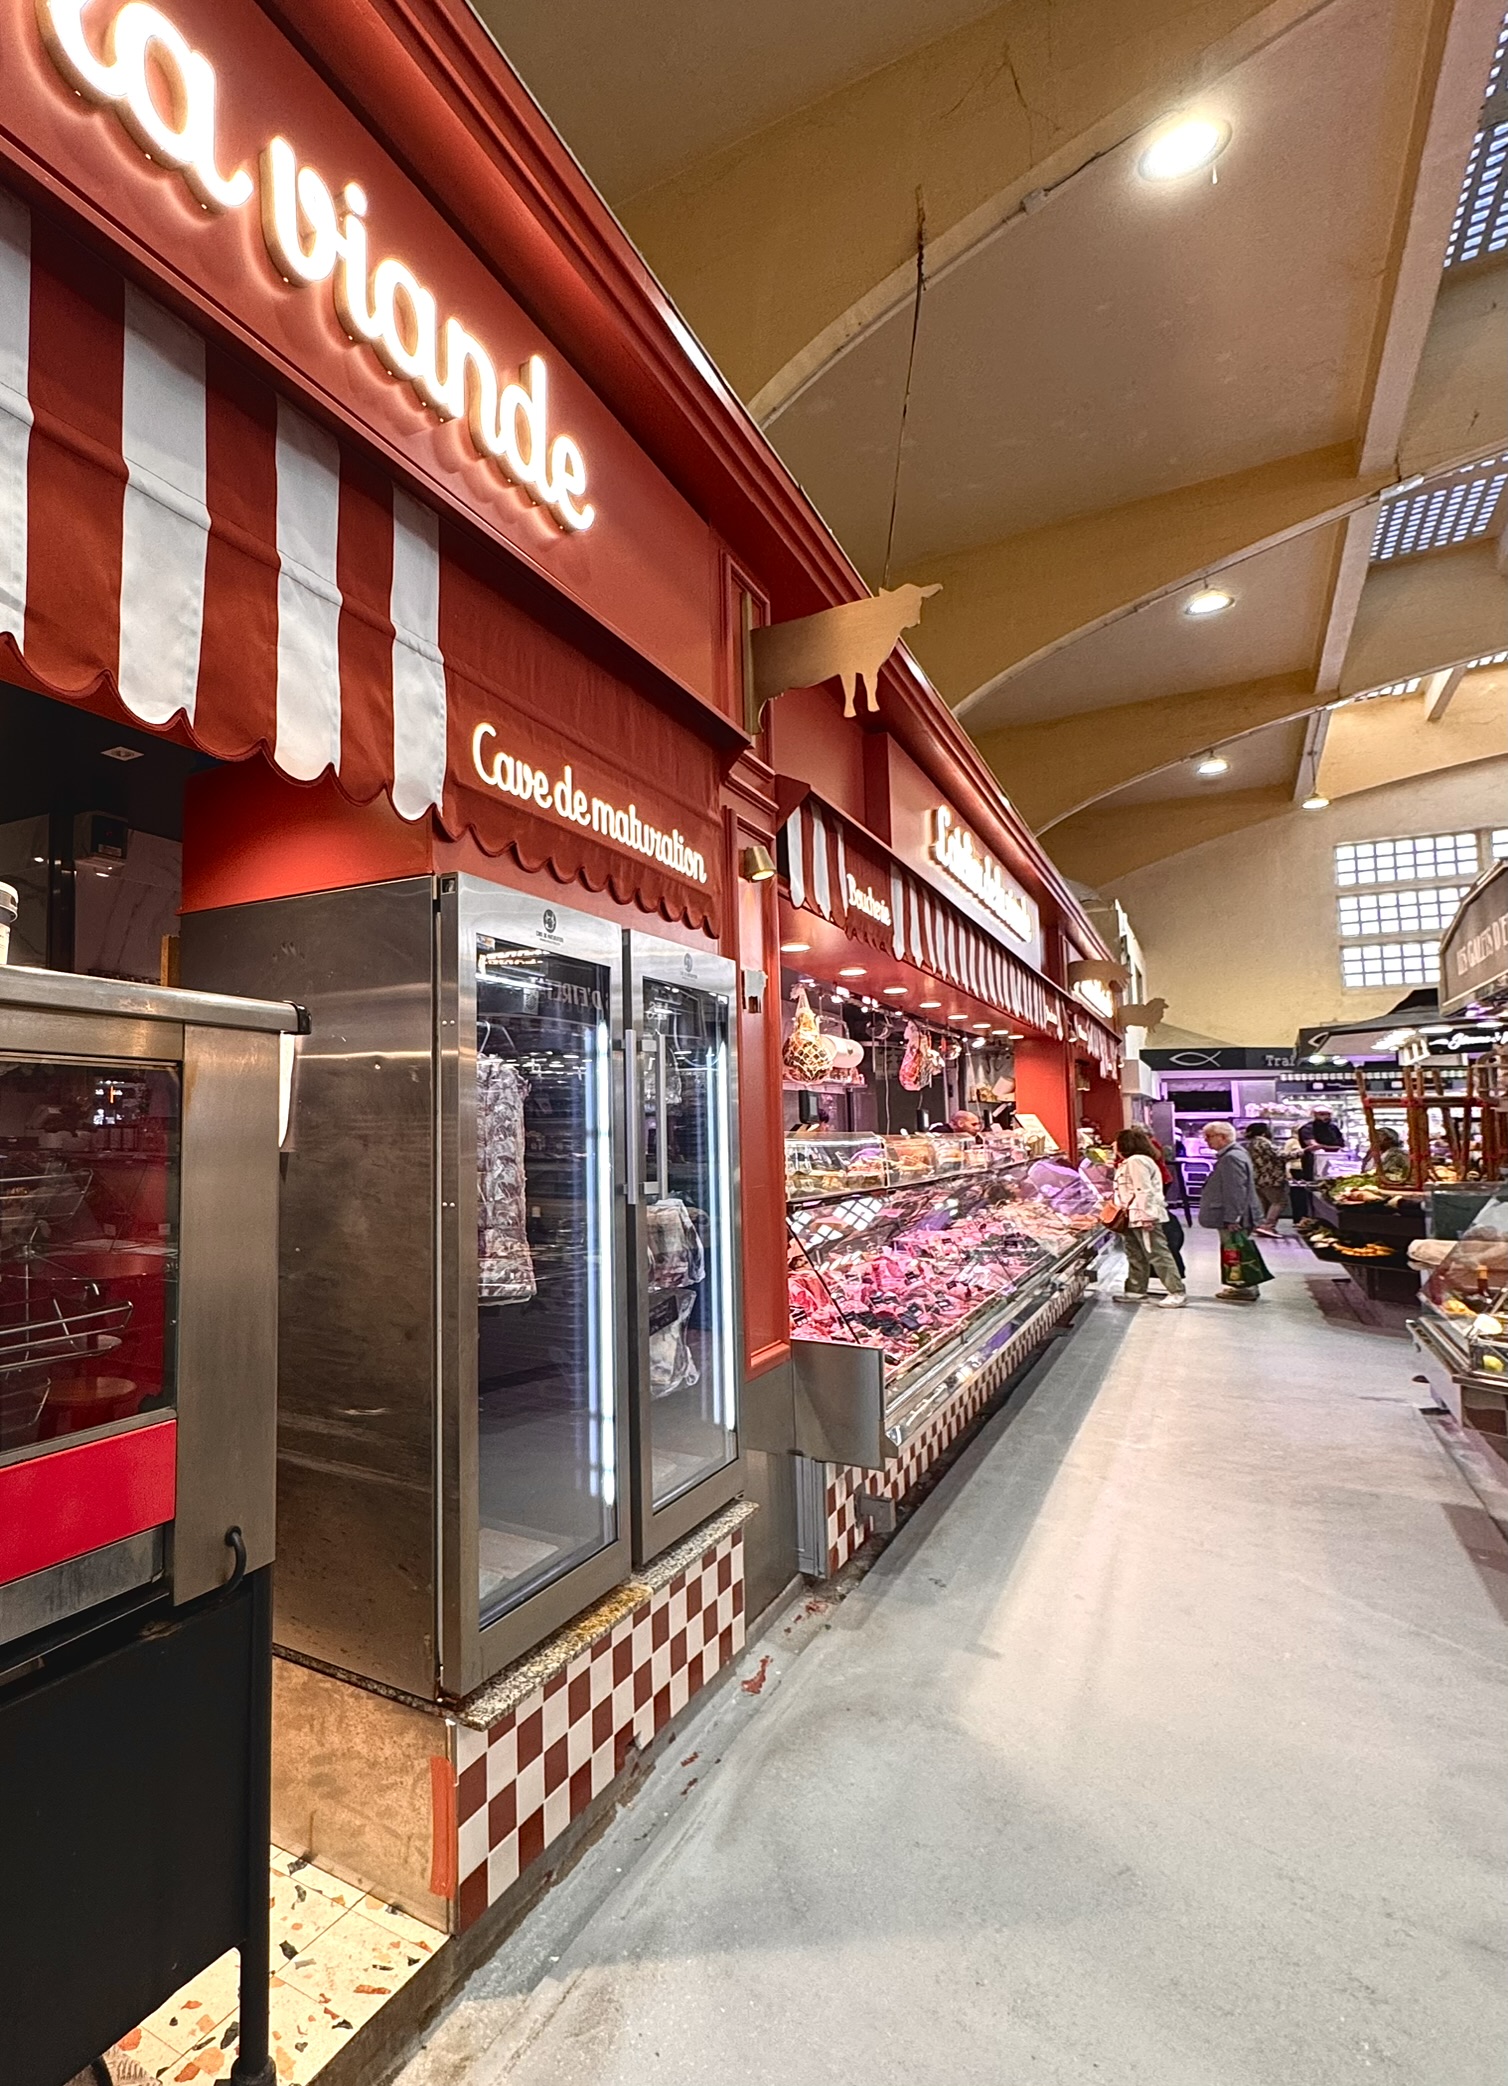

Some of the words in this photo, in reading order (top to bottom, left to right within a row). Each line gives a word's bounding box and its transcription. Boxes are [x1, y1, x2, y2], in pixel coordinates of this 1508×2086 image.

[261, 135, 595, 533] viande
[472, 722, 552, 809] Cave
[553, 765, 591, 826] de
[592, 797, 707, 884] maturation
[846, 873, 892, 927] Boucherie
